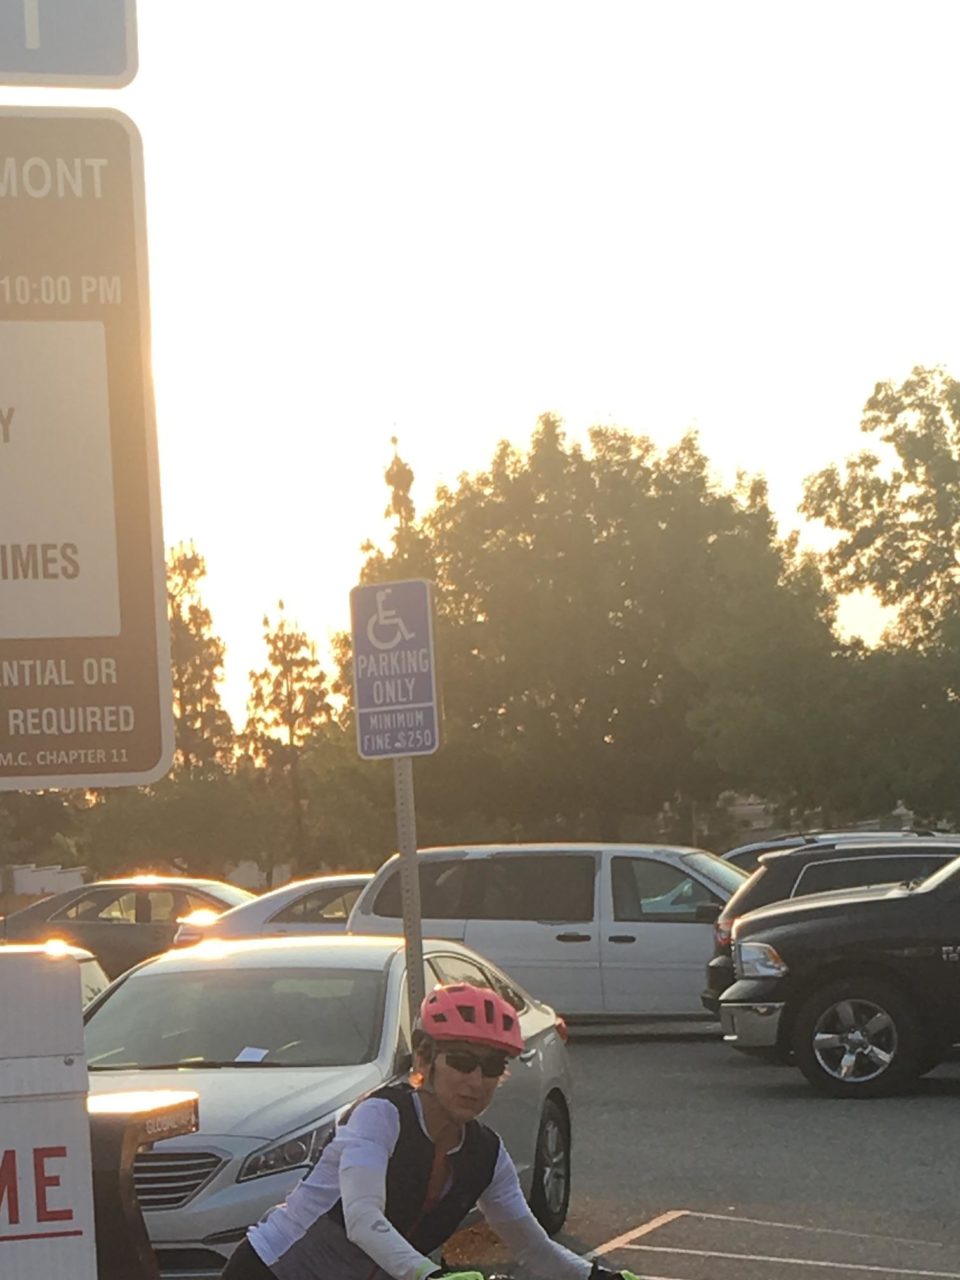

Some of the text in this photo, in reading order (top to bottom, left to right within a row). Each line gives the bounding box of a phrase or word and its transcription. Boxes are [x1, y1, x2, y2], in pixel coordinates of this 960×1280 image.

[0, 275, 71, 305] 10:00
[81, 276, 122, 305] PM
[83, 658, 117, 685] OR
[358, 649, 428, 678] PARKING
[373, 679, 415, 704] ONLY
[8, 705, 135, 736] REQUIRED
[370, 711, 424, 730] MINIMUM
[365, 735, 392, 750] FINE
[36, 750, 106, 765] CHAPTER
[111, 749, 128, 763] 11
